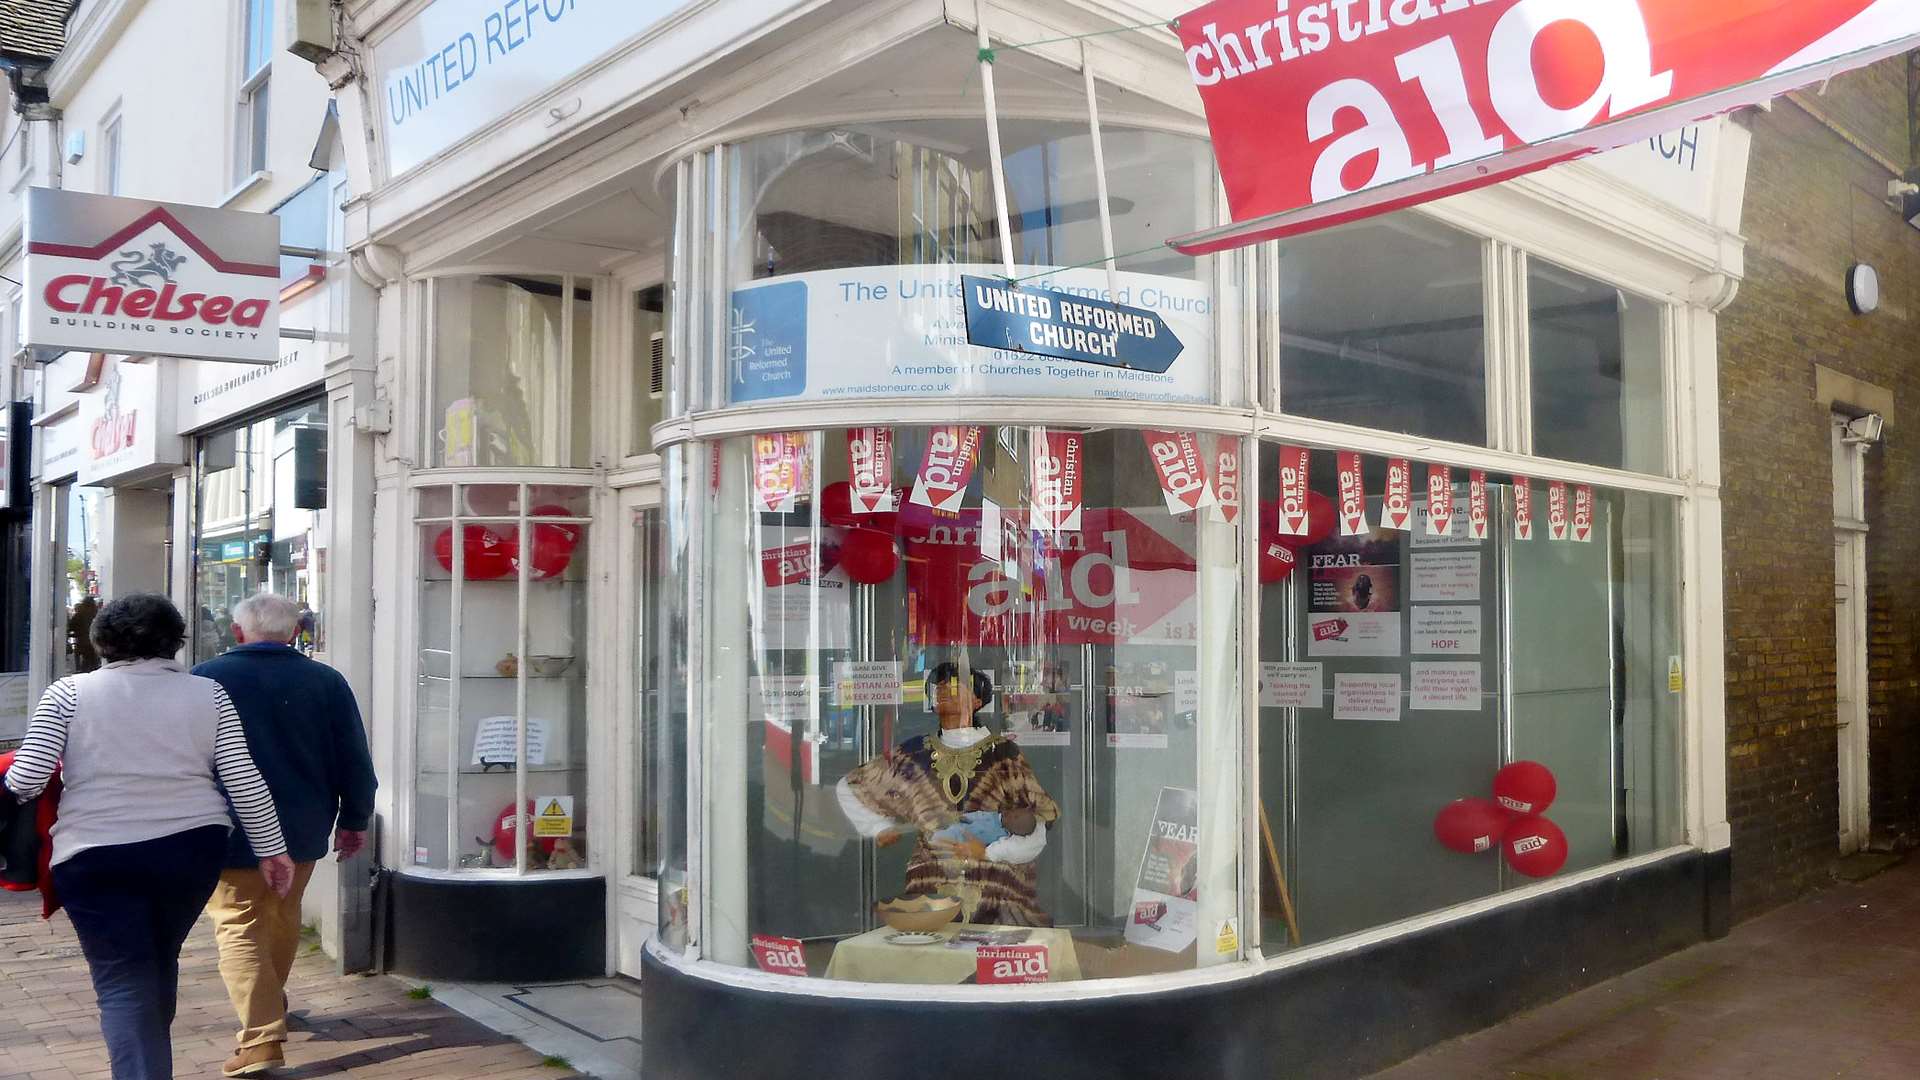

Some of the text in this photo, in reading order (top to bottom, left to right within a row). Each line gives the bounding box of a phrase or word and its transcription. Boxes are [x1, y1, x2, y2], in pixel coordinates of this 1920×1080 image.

[1185, 0, 1488, 88] christia
[388, 32, 477, 126] UNITED
[1306, 0, 1674, 204] aid
[43, 274, 272, 329] Chelsea
[839, 282, 888, 302] The
[899, 279, 964, 299] Unite
[50, 317, 260, 340] BUILDING SOCIETY
[976, 285, 1156, 340] UNITED REFORMED
[765, 345, 791, 356] United
[1029, 322, 1118, 357] CHURCH
[762, 371, 791, 381] Church
[891, 365, 1174, 383] A member of Churches Together in Maidstone
[850, 440, 884, 495] aid
[925, 431, 959, 492] aid
[1064, 437, 1077, 496] christian
[1152, 440, 1203, 497] aid
[1218, 452, 1239, 507] aid
[1034, 454, 1075, 512] aid
[1281, 466, 1305, 518] aid
[1340, 471, 1361, 519] aid
[1388, 466, 1408, 514] aid
[1430, 475, 1448, 521] aid
[1470, 480, 1485, 524] aid
[1515, 484, 1529, 526] aid
[1549, 487, 1565, 527] aid
[1575, 490, 1590, 529] aid
[762, 549, 807, 561] christian
[967, 528, 1141, 619] aid
[1312, 554, 1360, 568] FEAR
[1067, 615, 1136, 637] week
[1431, 640, 1460, 648] HOPE
[837, 681, 900, 690] CHRISTIAN AID
[1521, 838, 1541, 851] aid
[1140, 903, 1158, 920] aid
[752, 938, 789, 952] christian
[766, 946, 806, 969] aid
[977, 950, 1030, 959] christian
[993, 952, 1048, 978] aid
